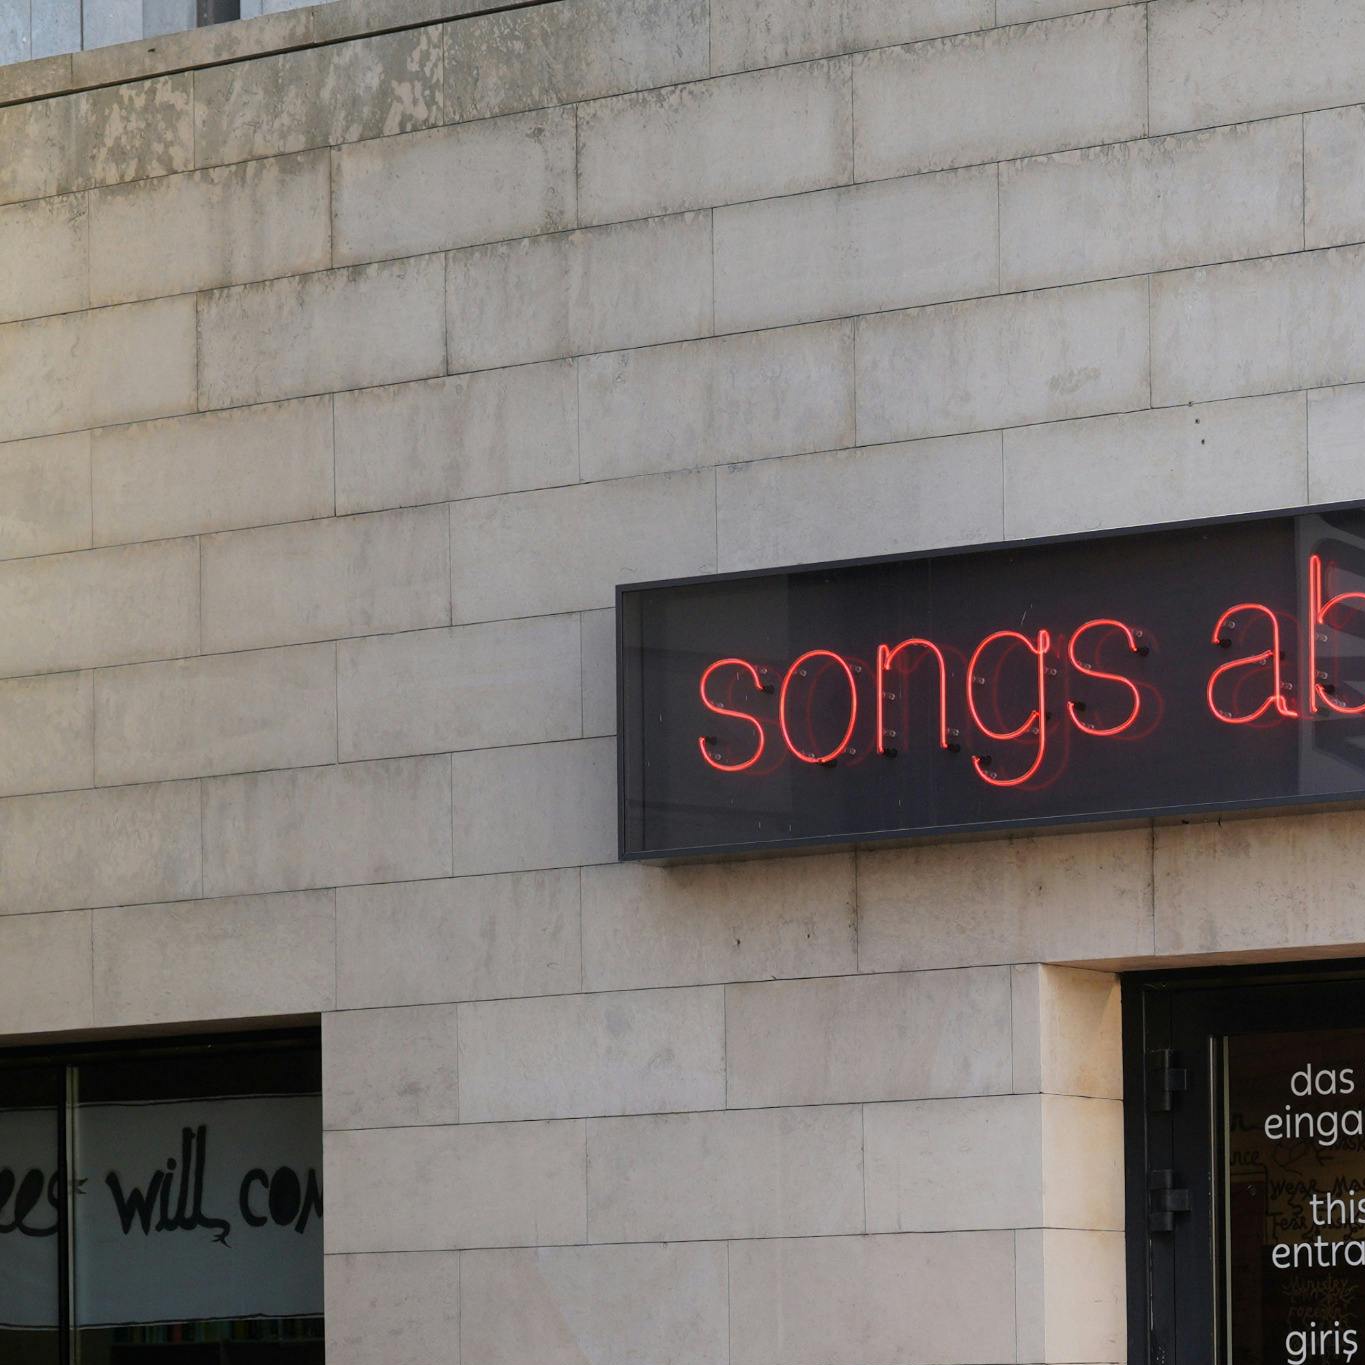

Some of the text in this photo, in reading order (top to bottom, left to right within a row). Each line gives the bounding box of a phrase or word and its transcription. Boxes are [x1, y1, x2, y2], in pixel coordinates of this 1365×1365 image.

[700, 619, 1140, 787] songs
[1290, 1063, 1355, 1097] das
[105, 1125, 230, 1247] will
[1285, 1320, 1358, 1365] giriş
